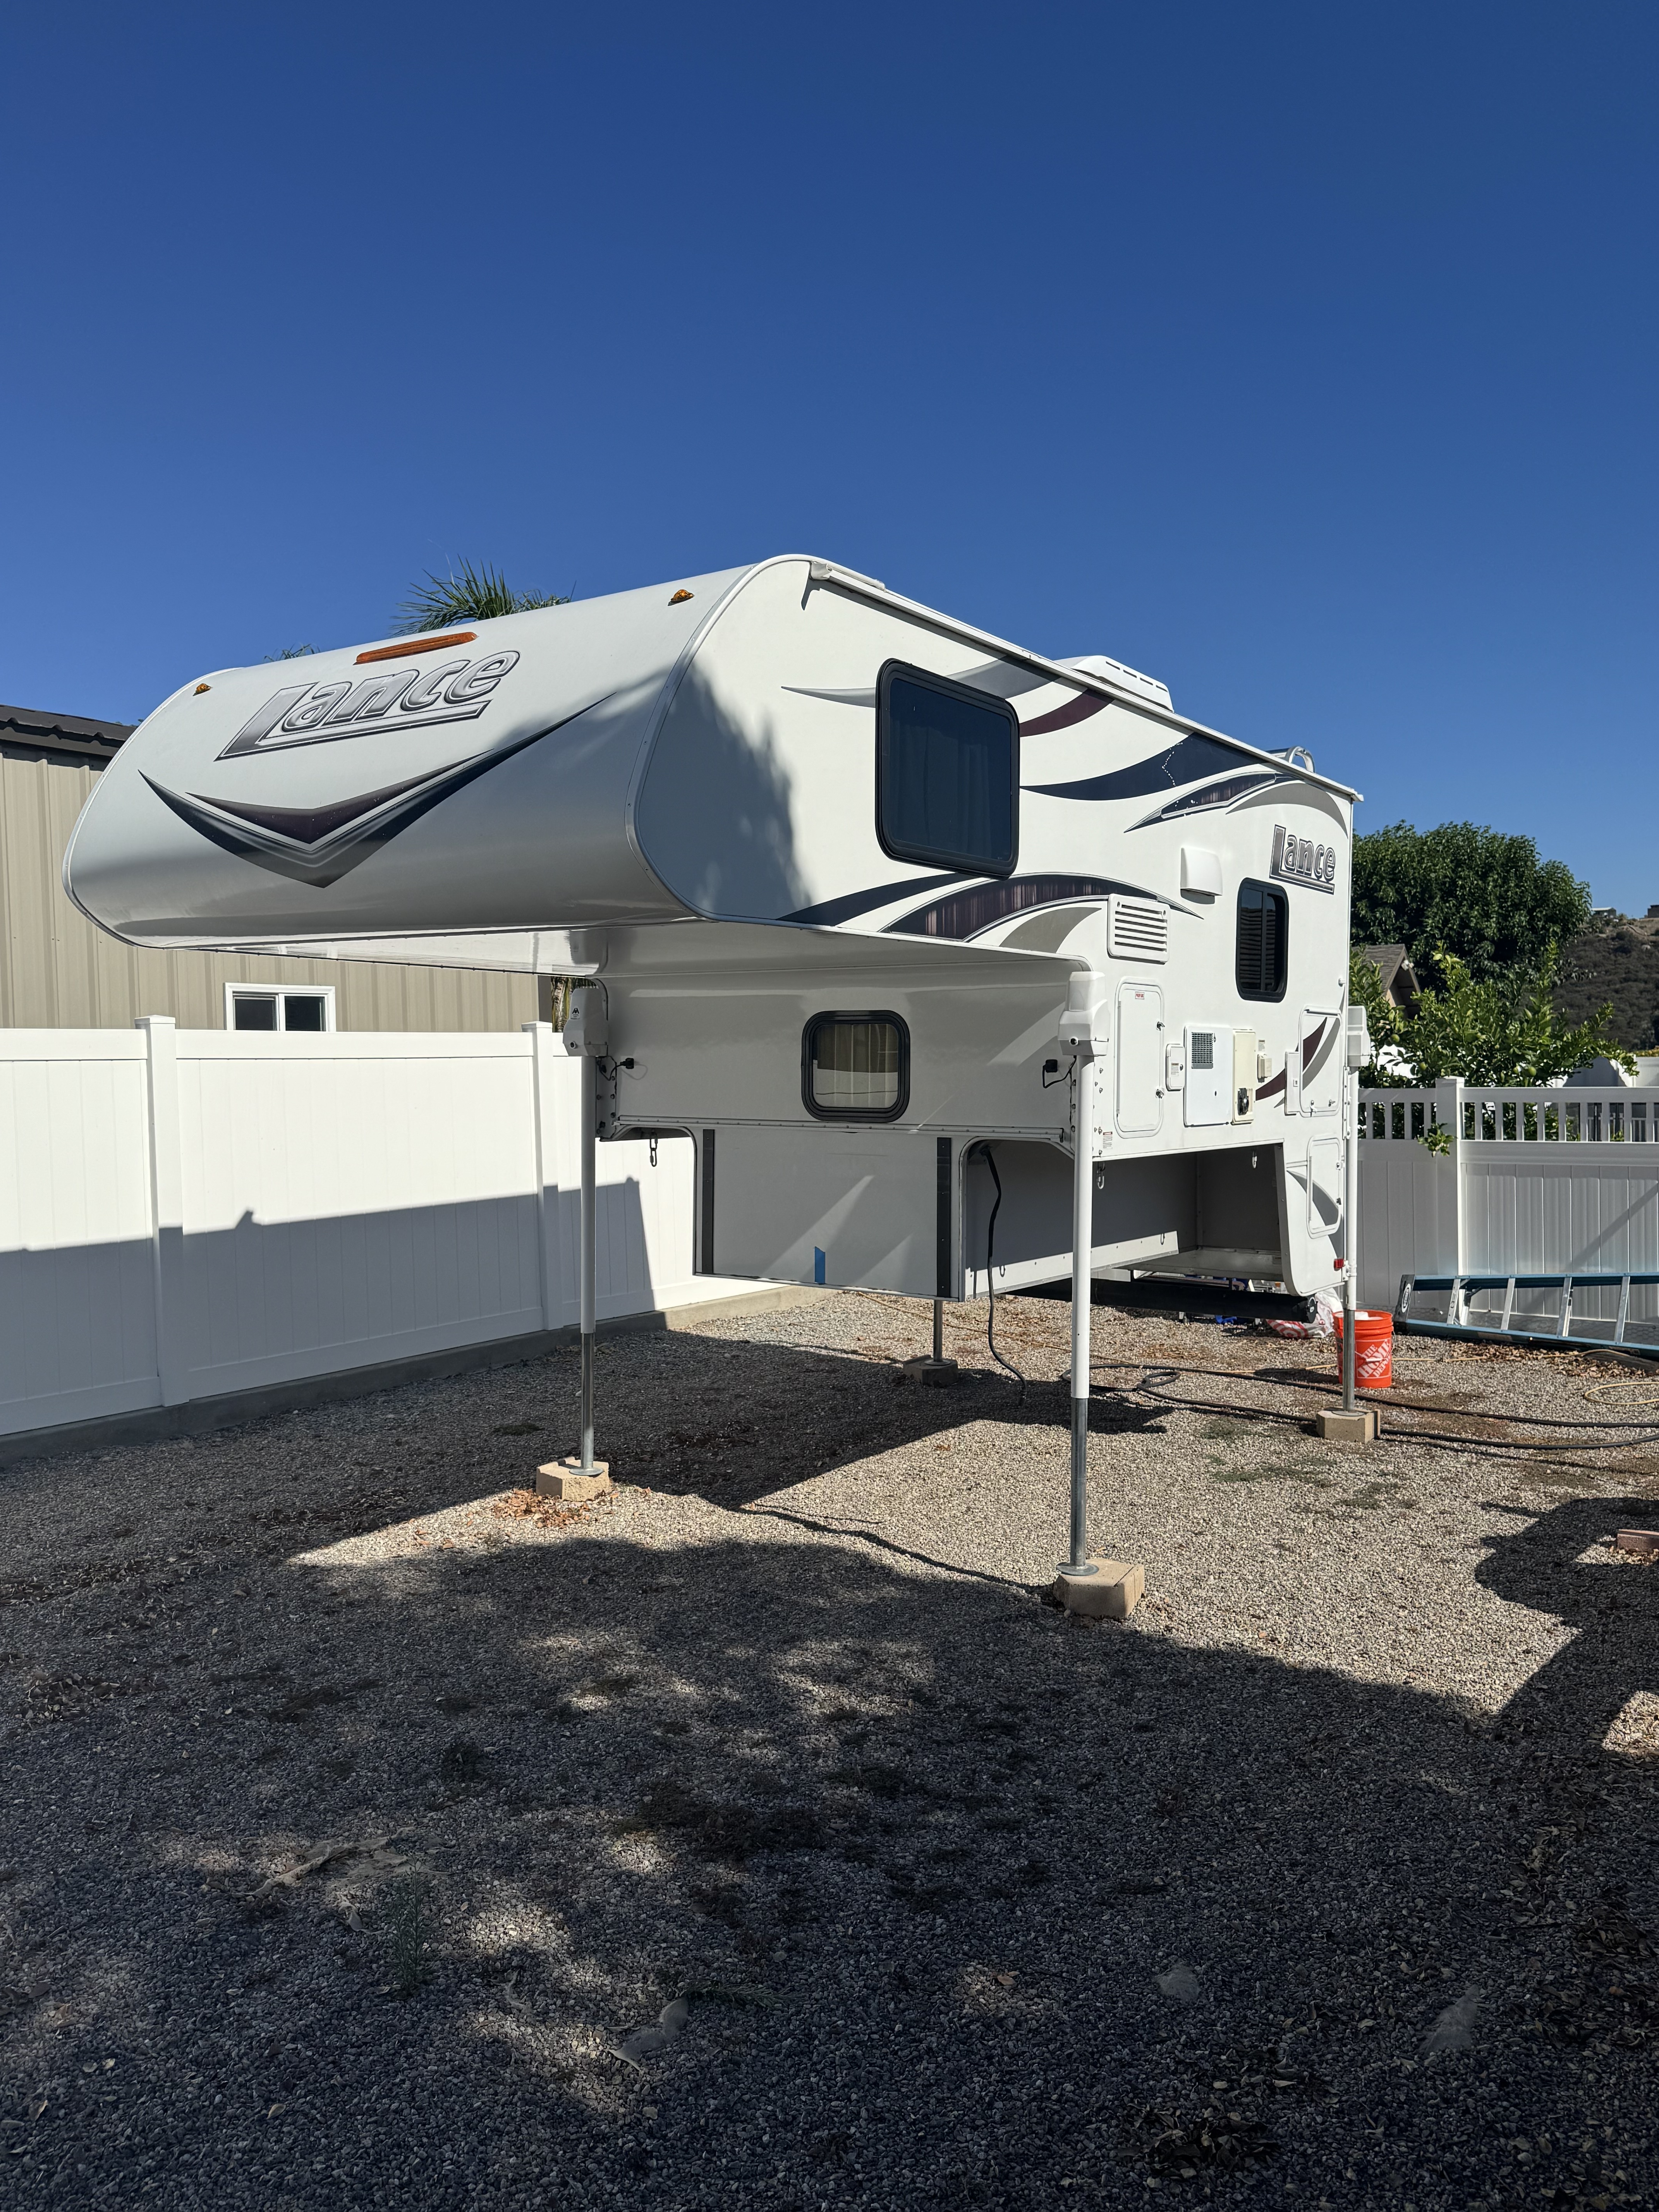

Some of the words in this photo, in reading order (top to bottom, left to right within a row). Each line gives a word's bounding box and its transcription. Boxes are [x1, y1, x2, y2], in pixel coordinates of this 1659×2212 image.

[214, 650, 520, 761] Lance
[1269, 824, 1336, 895] Lance
[1358, 1339, 1390, 1377] HOME
[1362, 1344, 1377, 1358] THE
